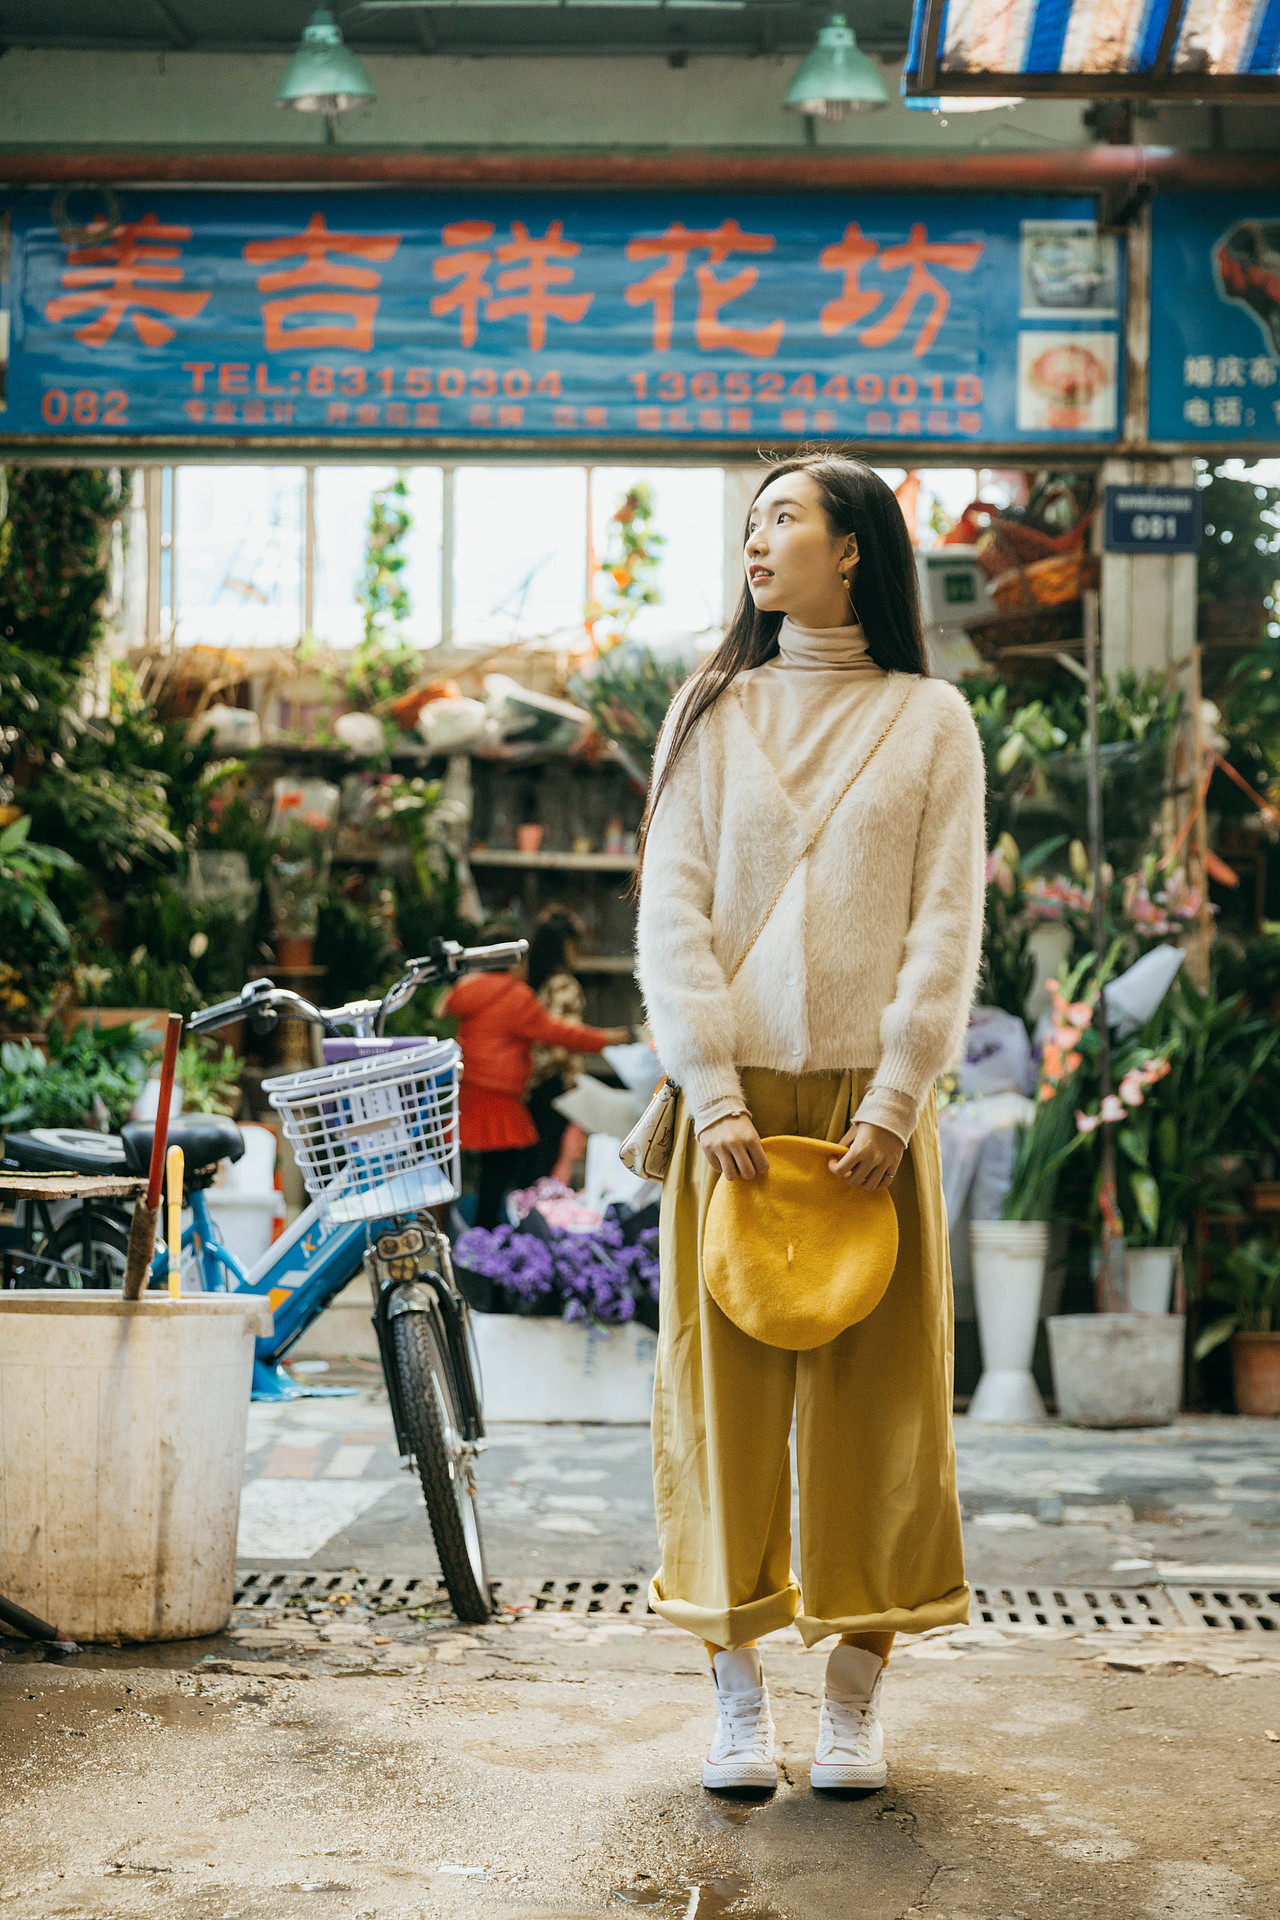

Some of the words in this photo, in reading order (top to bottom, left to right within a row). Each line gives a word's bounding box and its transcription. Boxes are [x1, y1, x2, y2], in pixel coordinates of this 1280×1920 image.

[182, 361, 563, 398] TEL:83150304
[629, 369, 983, 406] 13652449018
[42, 388, 129, 425] 082
